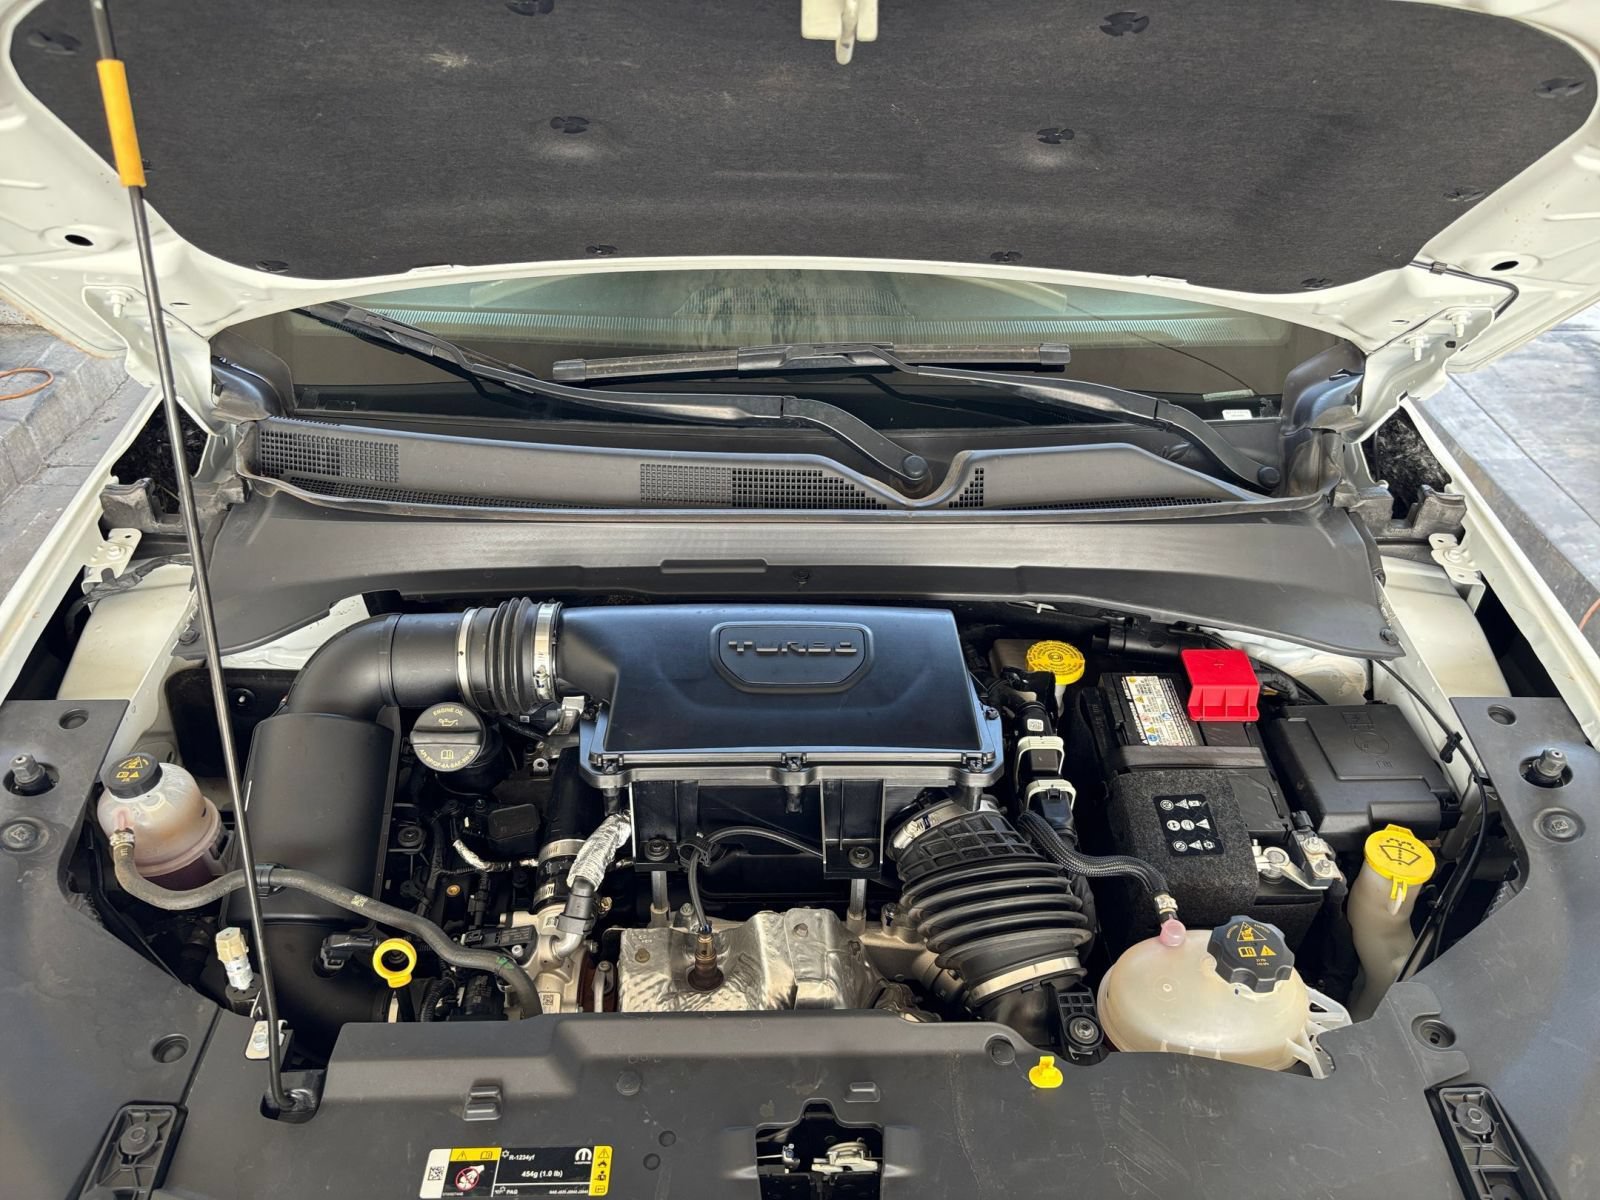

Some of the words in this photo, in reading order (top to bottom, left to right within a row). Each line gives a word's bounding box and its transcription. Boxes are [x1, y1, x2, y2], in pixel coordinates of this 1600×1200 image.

[728, 640, 857, 654] TURBO
[433, 707, 455, 716] ENGINE
[455, 708, 464, 717] OIL
[521, 1170, 539, 1179] 454g
[539, 1170, 553, 1178] (1.0
[553, 1169, 564, 1178] lb)
